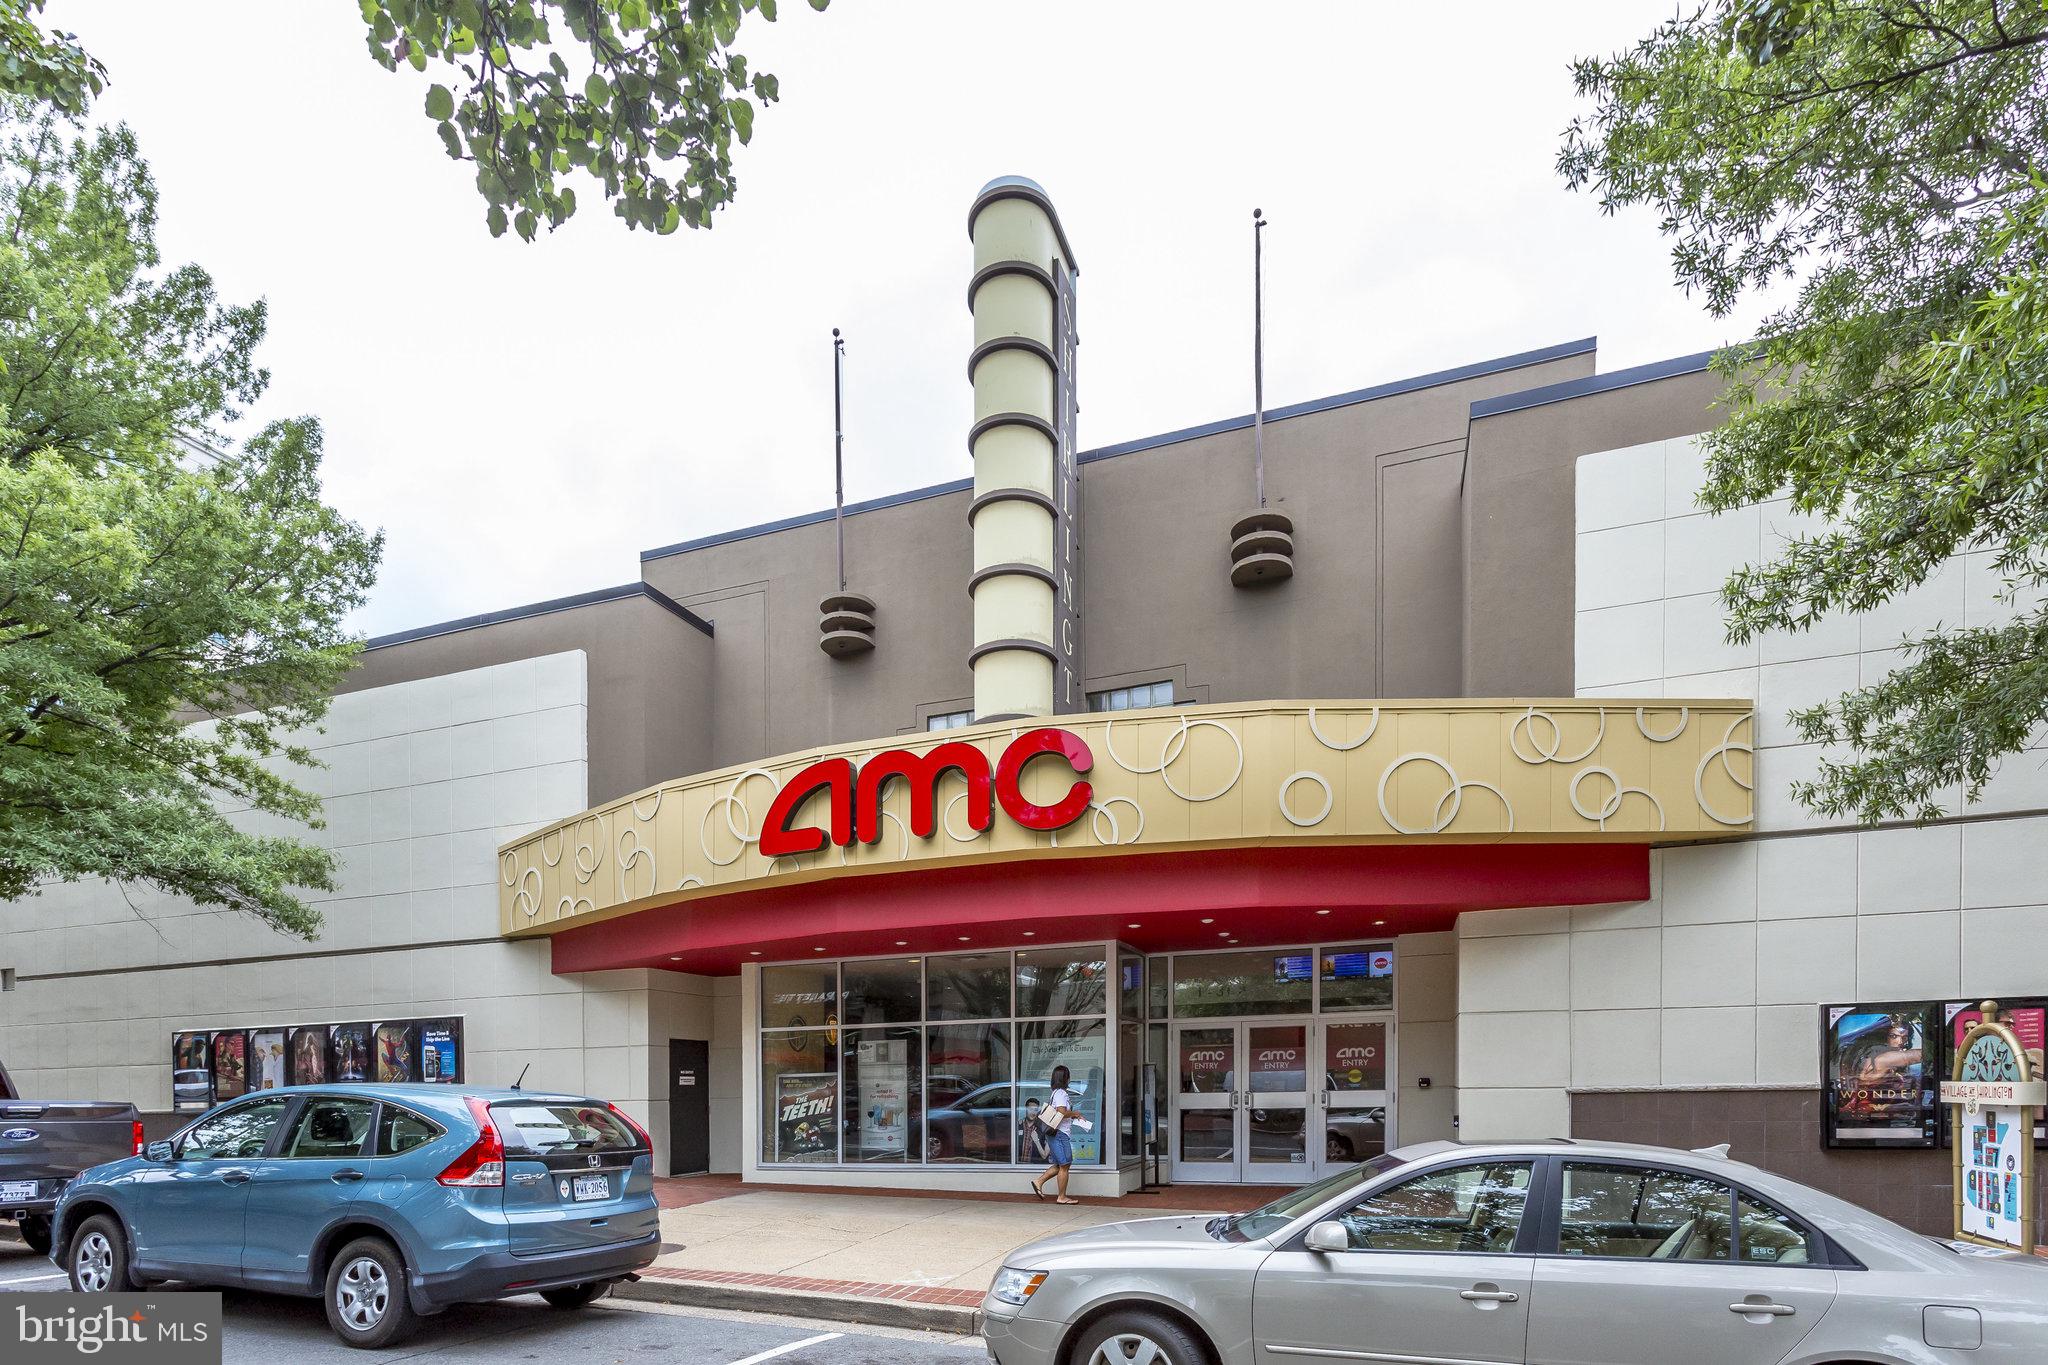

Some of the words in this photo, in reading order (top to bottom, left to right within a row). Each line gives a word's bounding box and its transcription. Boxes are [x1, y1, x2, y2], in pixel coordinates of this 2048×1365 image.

[1074, 1043, 1094, 1052] Times
[1194, 1062, 1219, 1070] ENTRY
[1264, 1061, 1290, 1070] ENTRY
[1342, 1058, 1369, 1067] ENTRY
[1840, 1089, 1918, 1099] WONDER
[795, 1094, 808, 1104] THE
[782, 1095, 835, 1122] TEETH!
[1752, 1247, 1775, 1255] ESC
